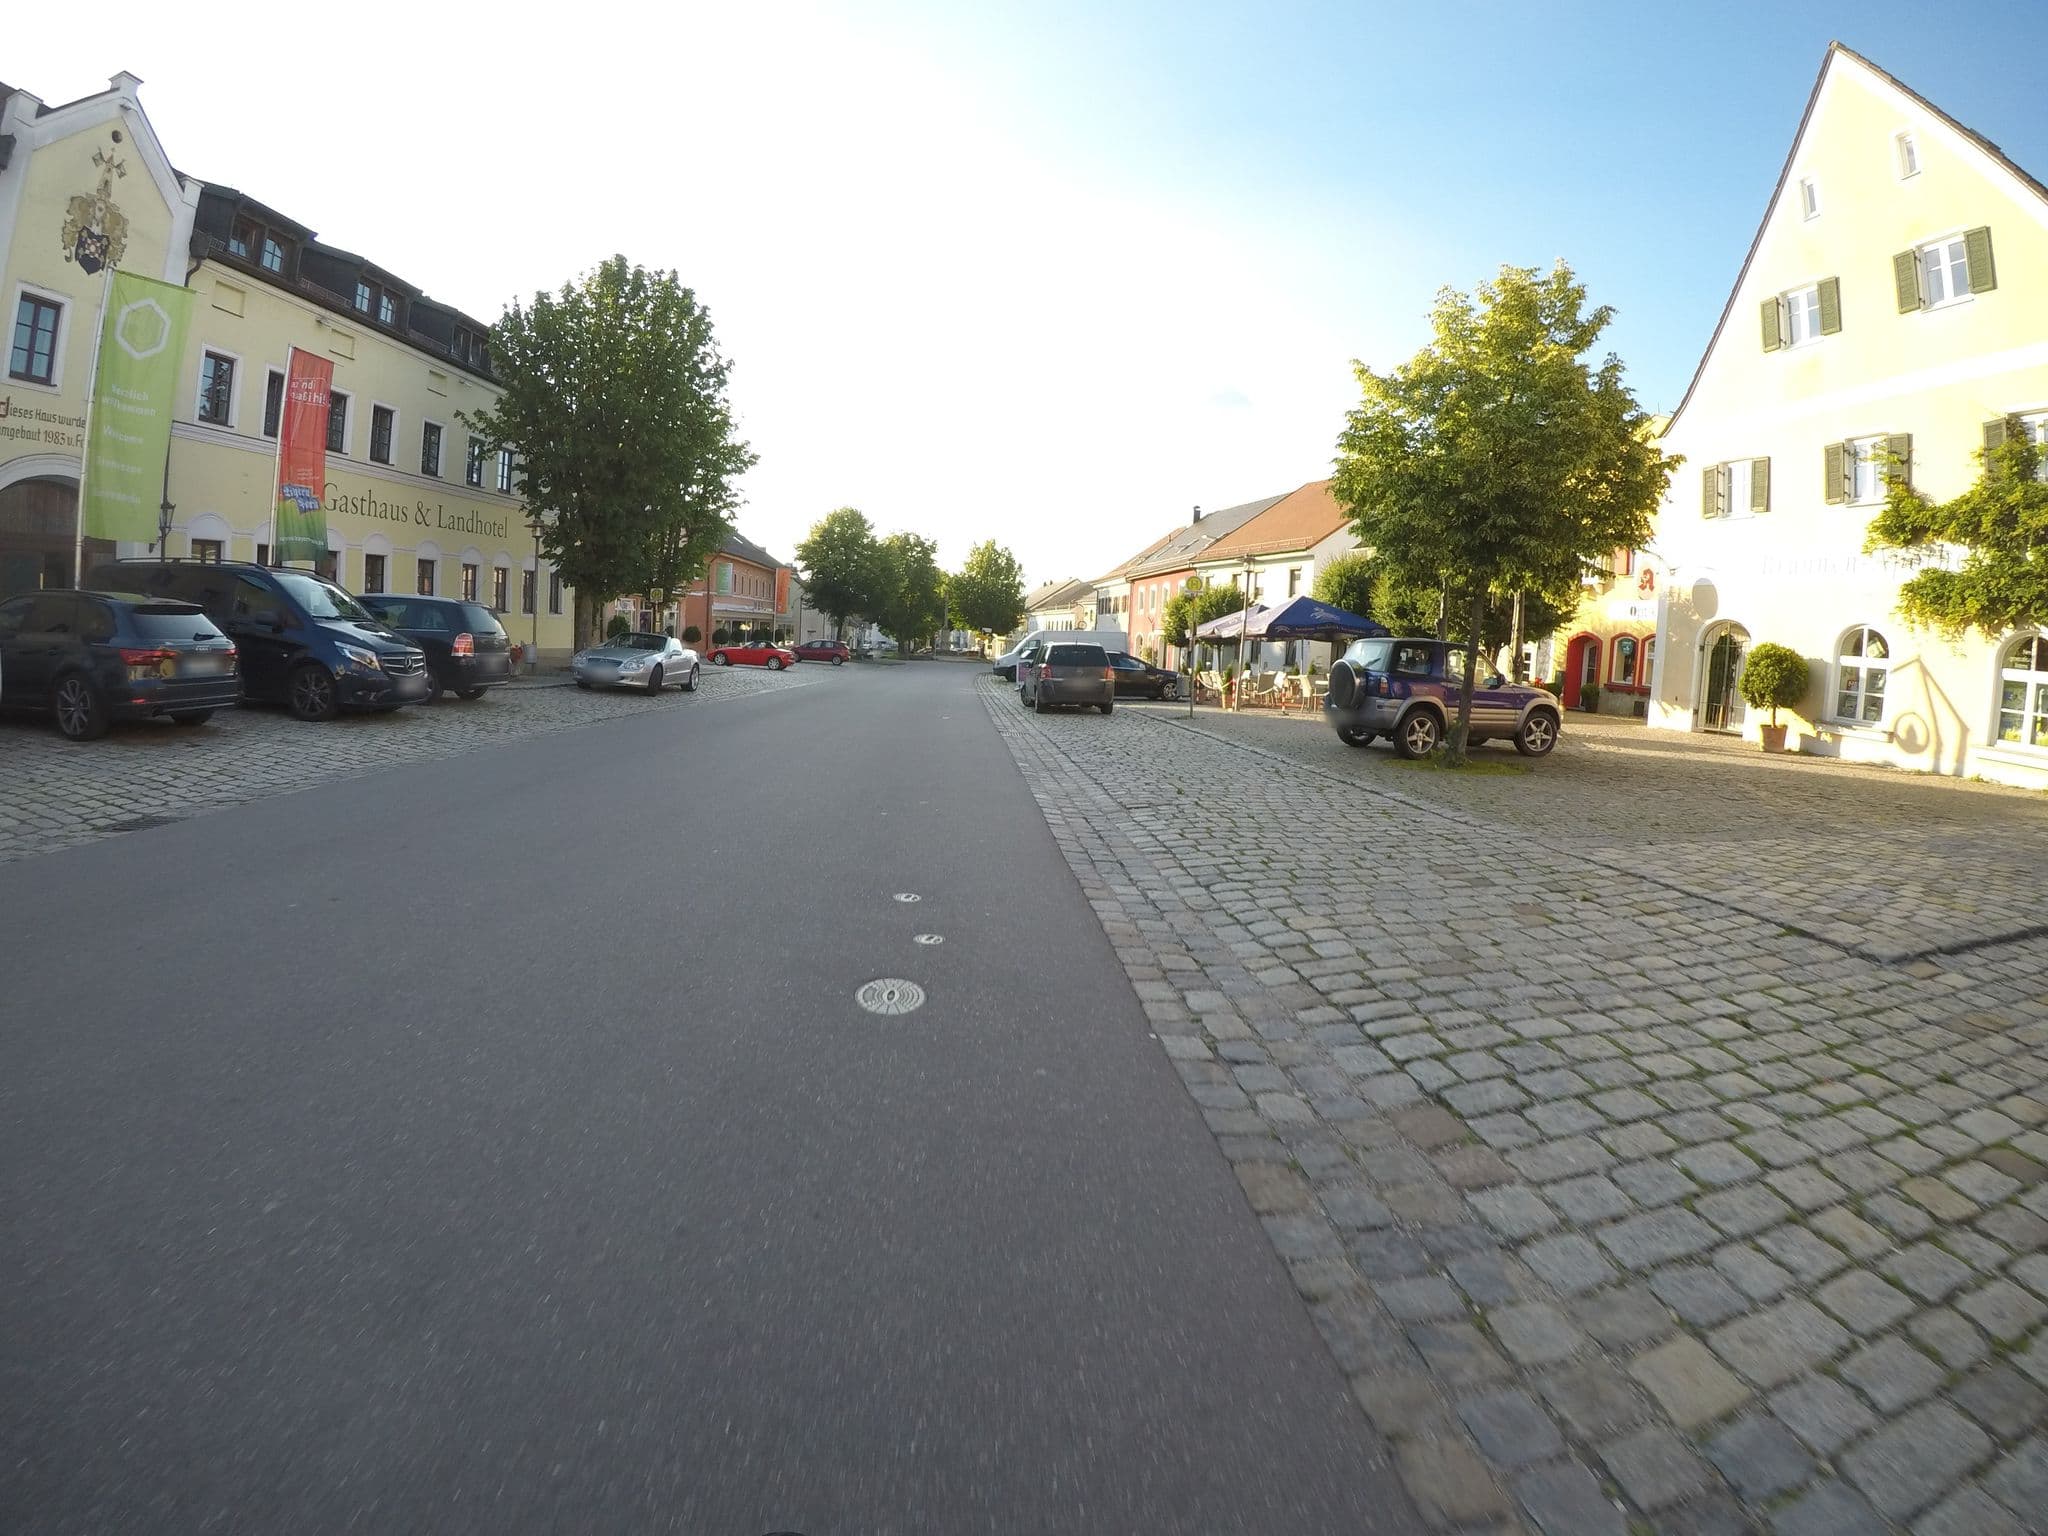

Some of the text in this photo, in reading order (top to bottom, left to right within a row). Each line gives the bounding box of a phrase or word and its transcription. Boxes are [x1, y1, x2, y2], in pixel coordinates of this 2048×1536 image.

[35, 408, 58, 424] Haus
[58, 415, 87, 429] wurde
[43, 430, 66, 446] 1983
[323, 482, 509, 539] Gasthaus & Landhotel
